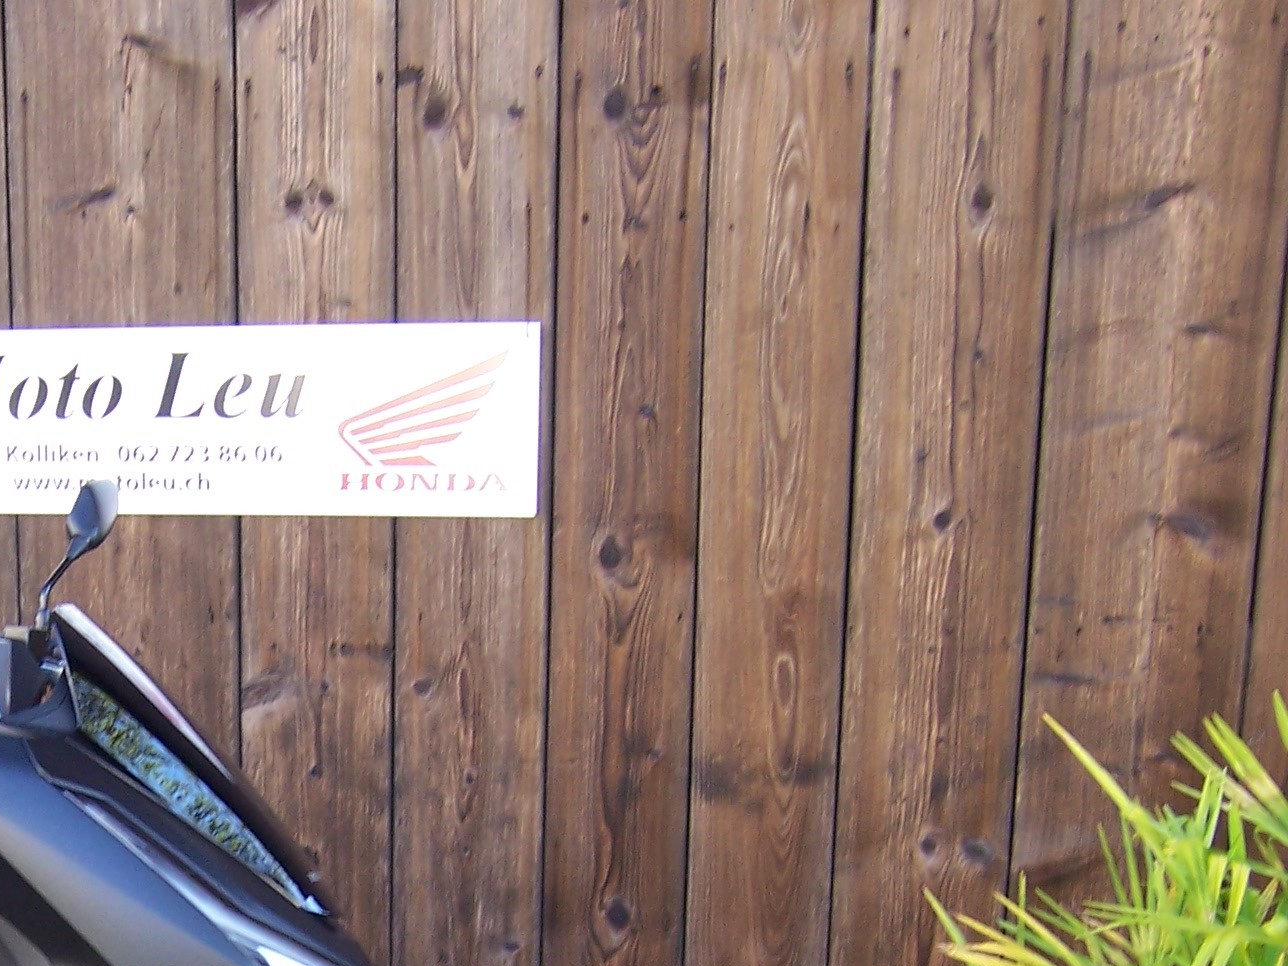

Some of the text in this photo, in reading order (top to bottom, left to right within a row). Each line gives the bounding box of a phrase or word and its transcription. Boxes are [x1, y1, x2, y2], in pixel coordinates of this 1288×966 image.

[155, 353, 308, 419] Leu
[118, 446, 159, 462] 062
[170, 446, 209, 462] 723
[219, 446, 246, 462] 86
[255, 446, 282, 462] 06
[14, 472, 210, 491] www.toleu.ch
[340, 473, 507, 491] HONDA
